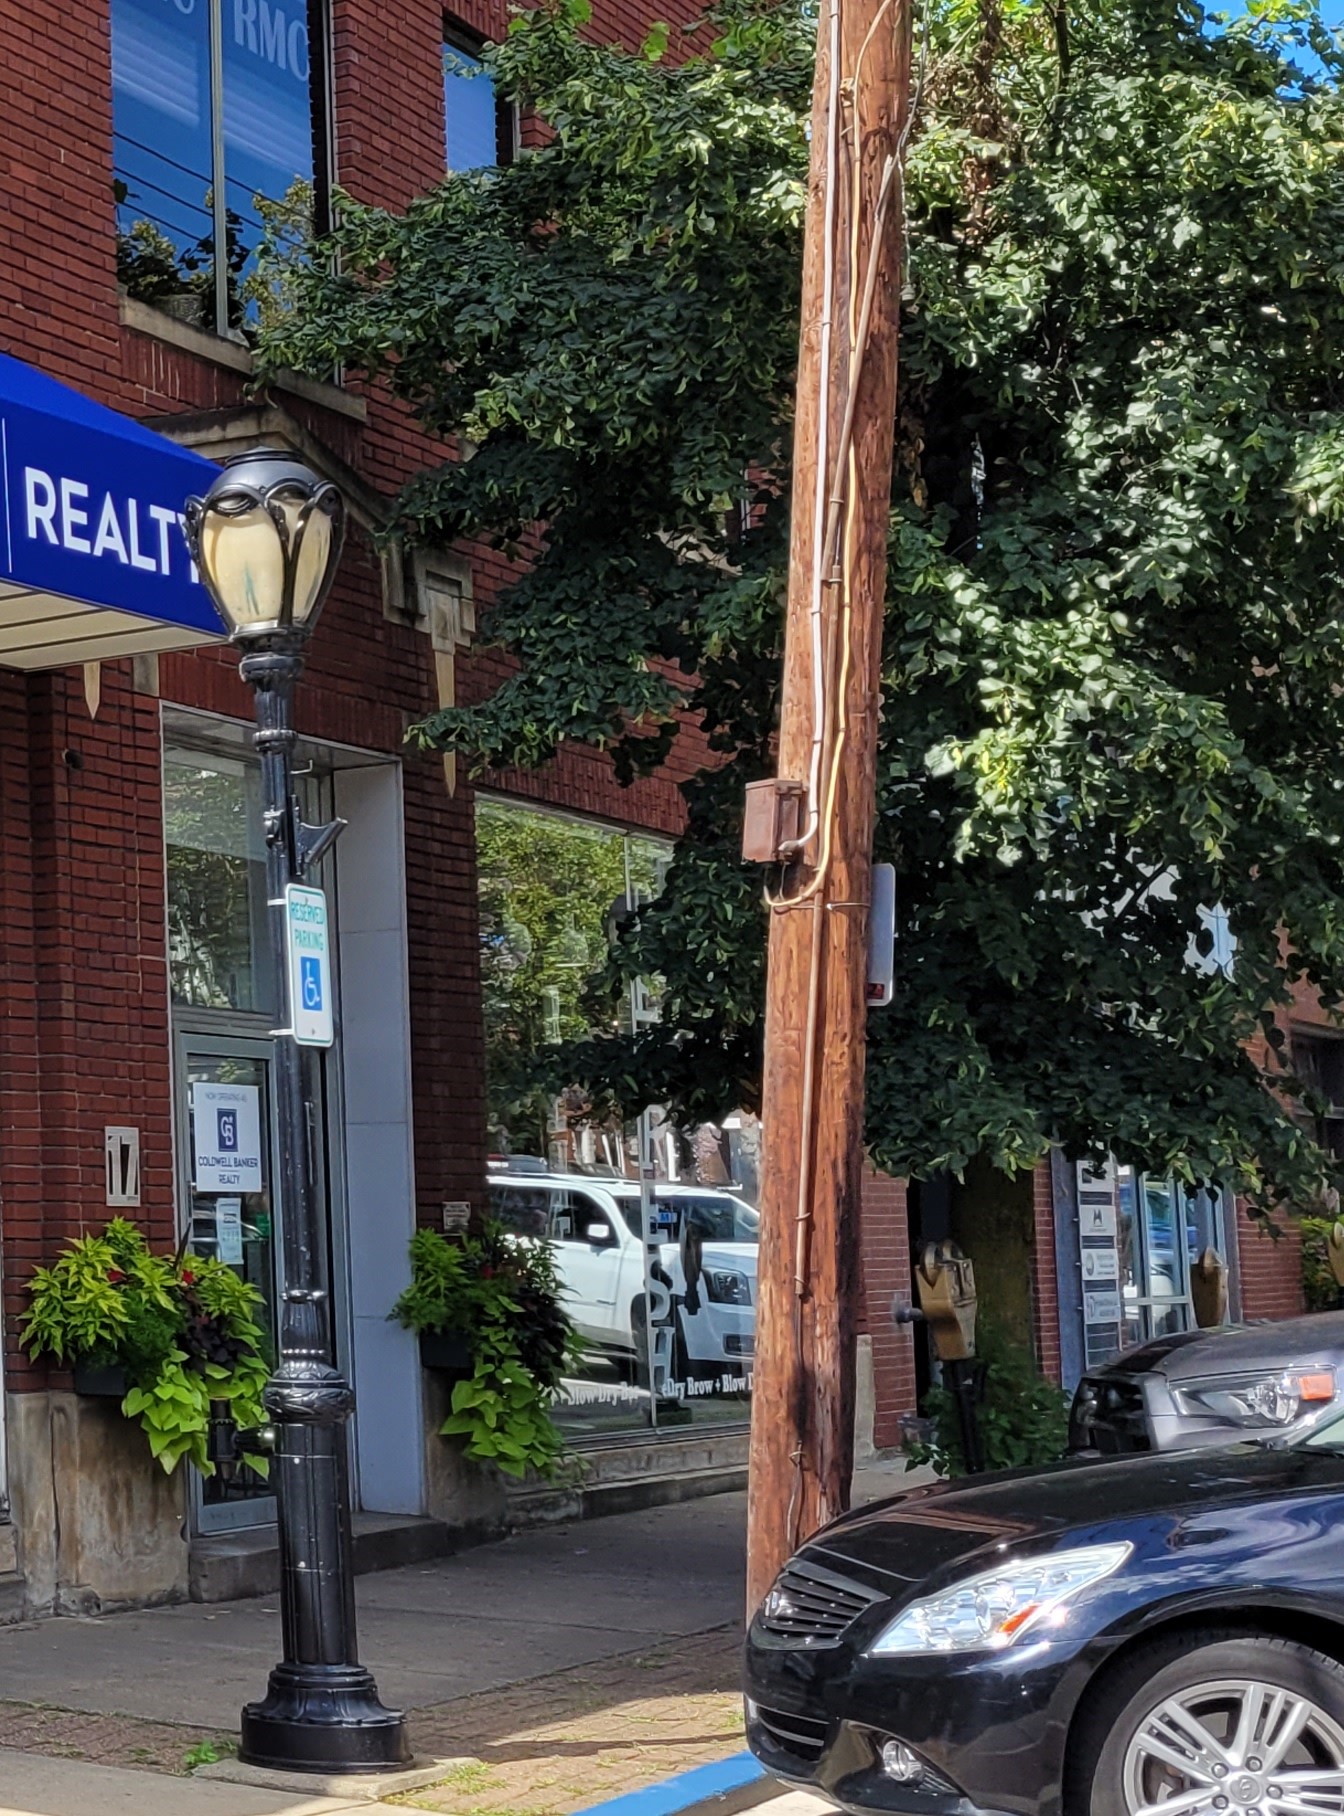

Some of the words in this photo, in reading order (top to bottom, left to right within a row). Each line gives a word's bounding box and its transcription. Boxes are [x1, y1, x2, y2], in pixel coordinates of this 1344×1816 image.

[291, 901, 324, 924] RESERVED
[294, 928, 324, 951] PARKING
[108, 1135, 138, 1196] 17
[198, 1155, 232, 1168] COLDWELL
[234, 1157, 258, 1169] BANKER
[218, 1174, 240, 1185] REALTY
[687, 1376, 714, 1396] Brow
[721, 1373, 746, 1393] Blow
